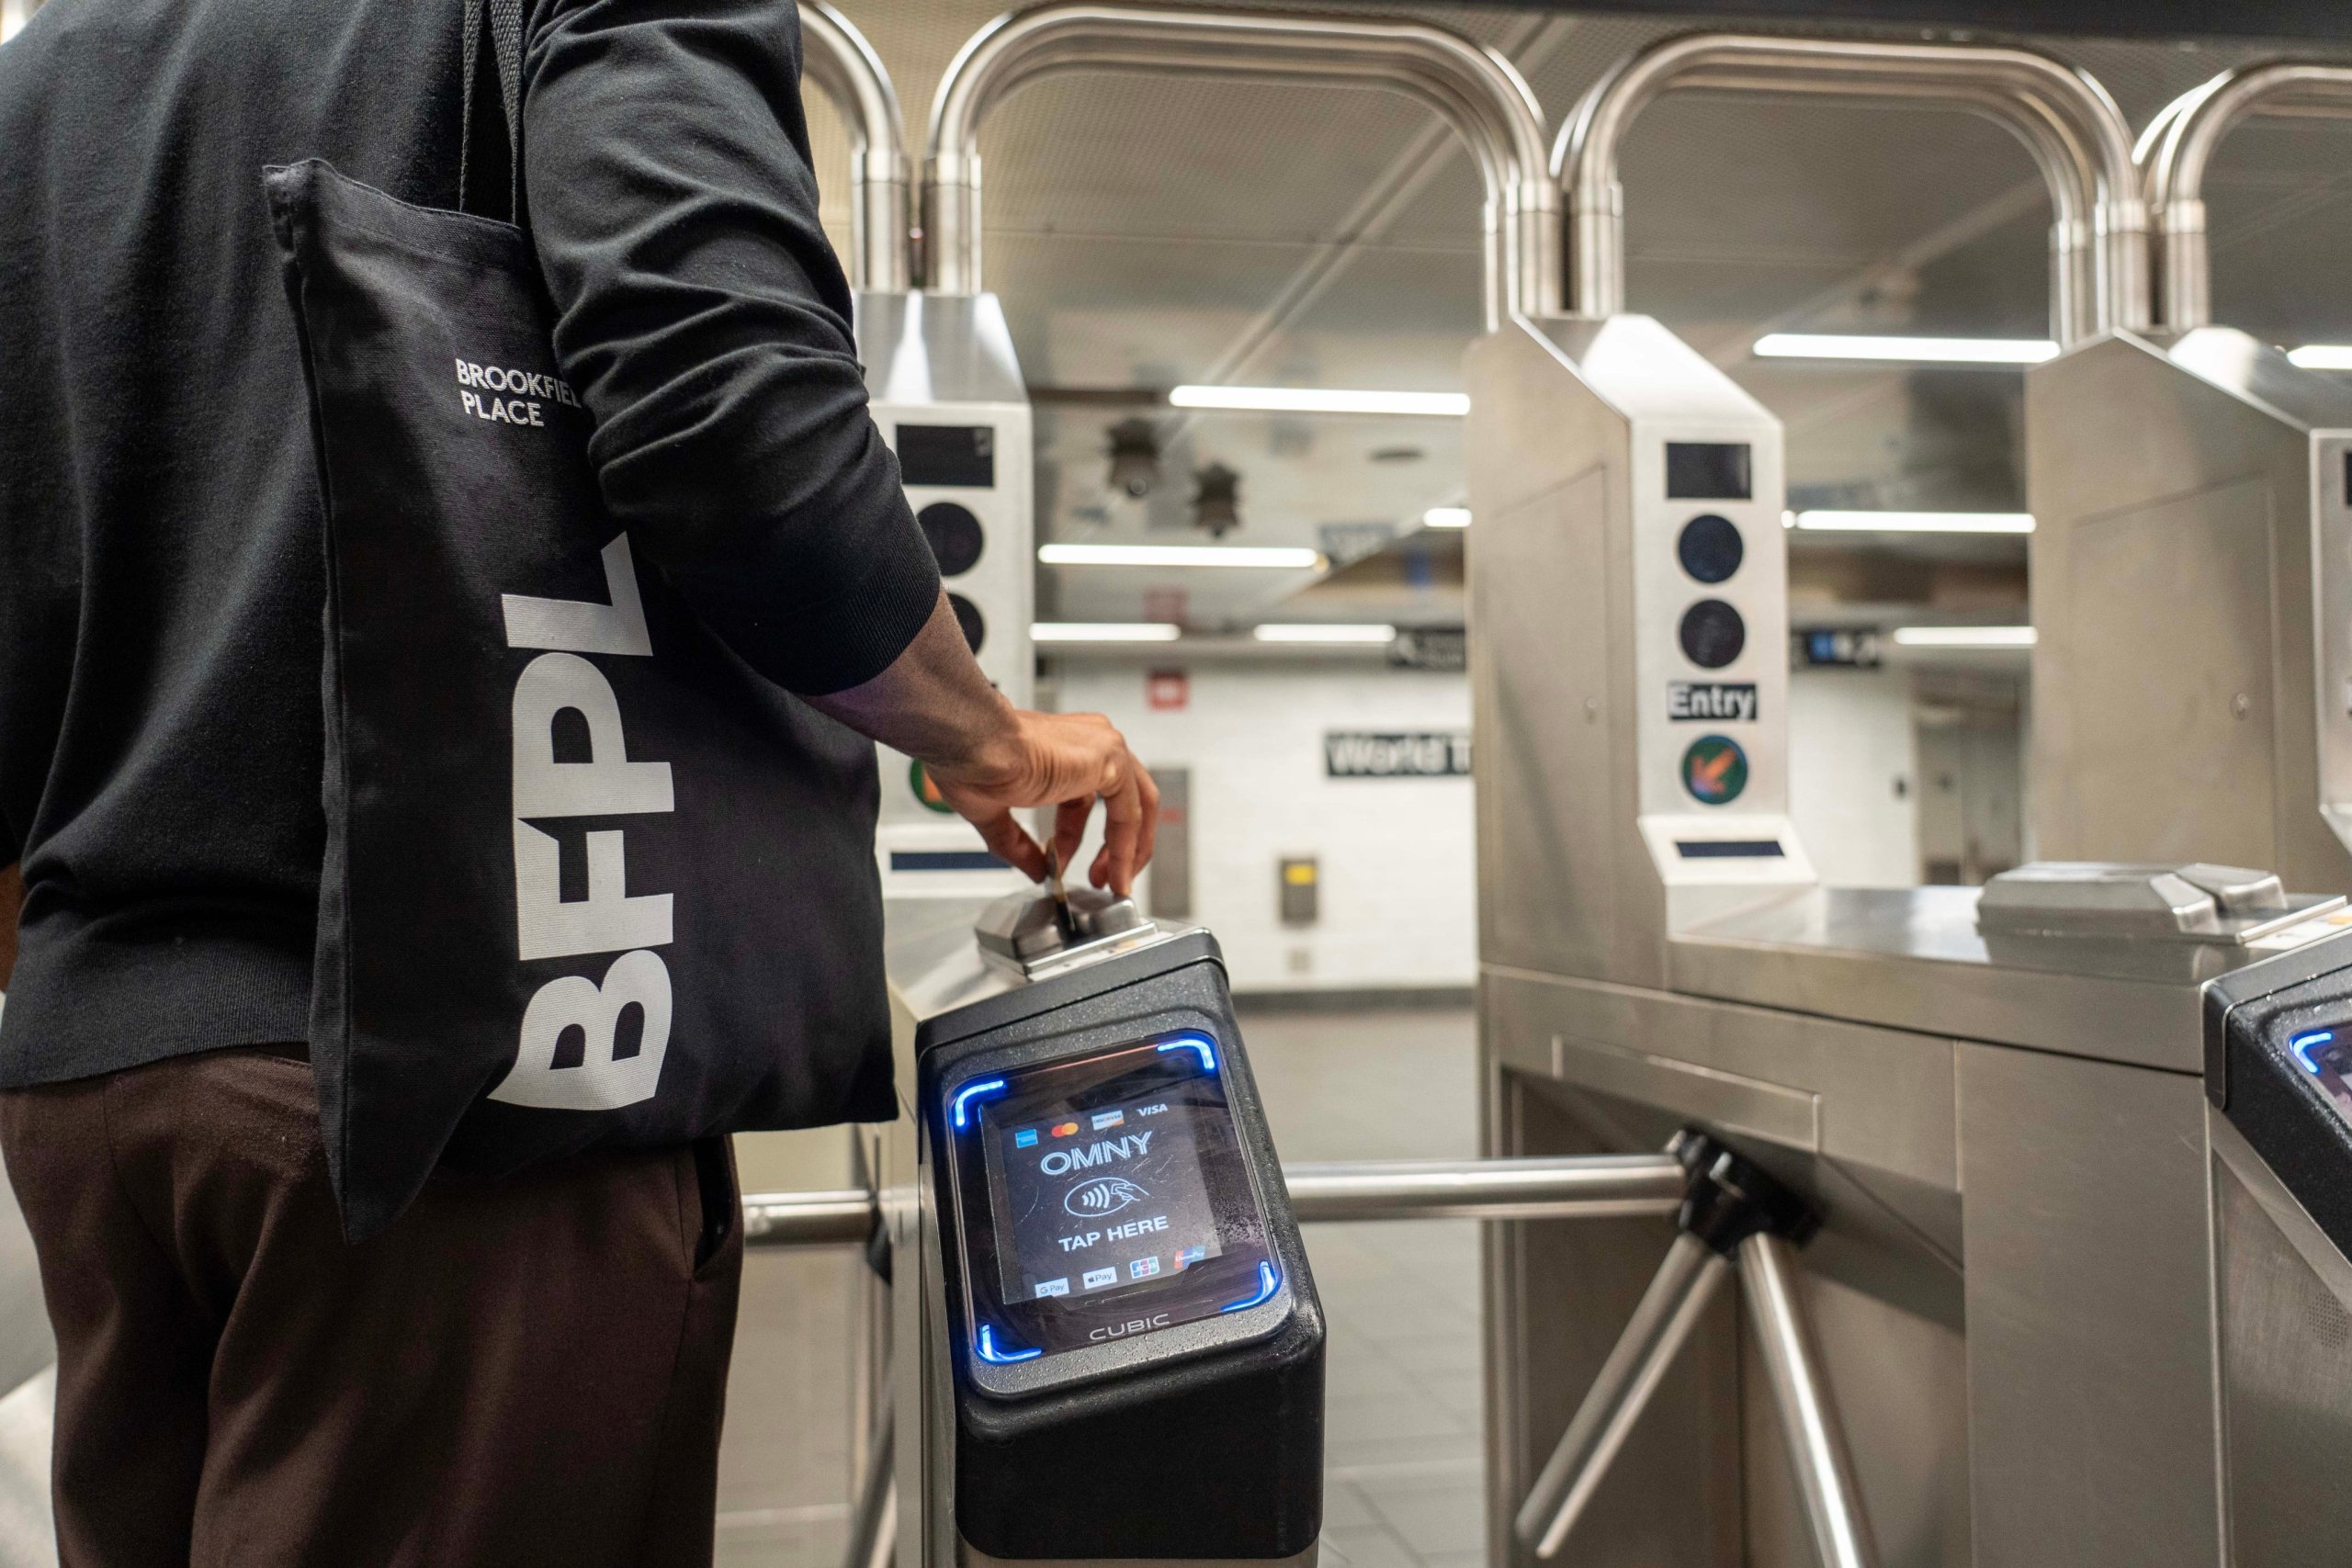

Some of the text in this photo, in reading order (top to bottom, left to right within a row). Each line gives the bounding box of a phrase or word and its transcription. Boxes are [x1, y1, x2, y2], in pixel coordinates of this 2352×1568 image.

[455, 358, 582, 409] BROOKFIEL
[460, 390, 544, 427] PLACE
[1668, 684, 1755, 721] Entry
[1329, 736, 1446, 773] World
[486, 530, 675, 1111] BFPL
[1136, 1103, 1169, 1117] VISA
[1040, 1131, 1152, 1176] OMNY
[1058, 1215, 1170, 1252] TAP HERE
[1095, 1272, 1113, 1281] Pay
[1133, 1262, 1158, 1273] JCB
[1050, 1283, 1065, 1293] Pay
[1089, 1313, 1170, 1340] CUBIC
